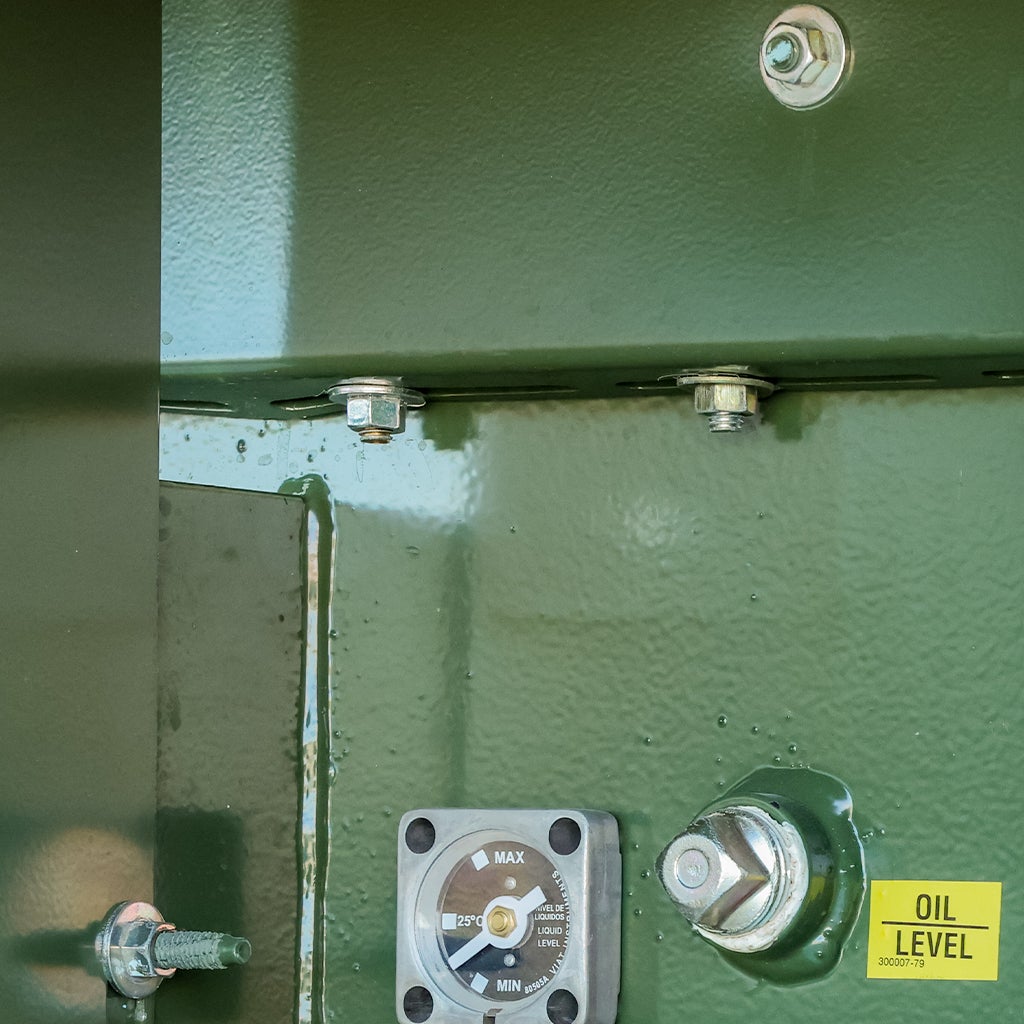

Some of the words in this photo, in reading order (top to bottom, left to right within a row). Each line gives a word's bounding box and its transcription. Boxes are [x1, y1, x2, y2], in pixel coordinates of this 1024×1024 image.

[495, 851, 525, 864] MAX
[556, 904, 565, 912] DE
[916, 894, 956, 921] OIL
[535, 913, 565, 921] LIQUIDOS
[538, 927, 562, 935] LIQUID
[538, 940, 560, 948] LEVEL
[896, 930, 972, 960] LEVEL
[878, 957, 925, 968] 300007-79
[496, 979, 521, 992] MIN
